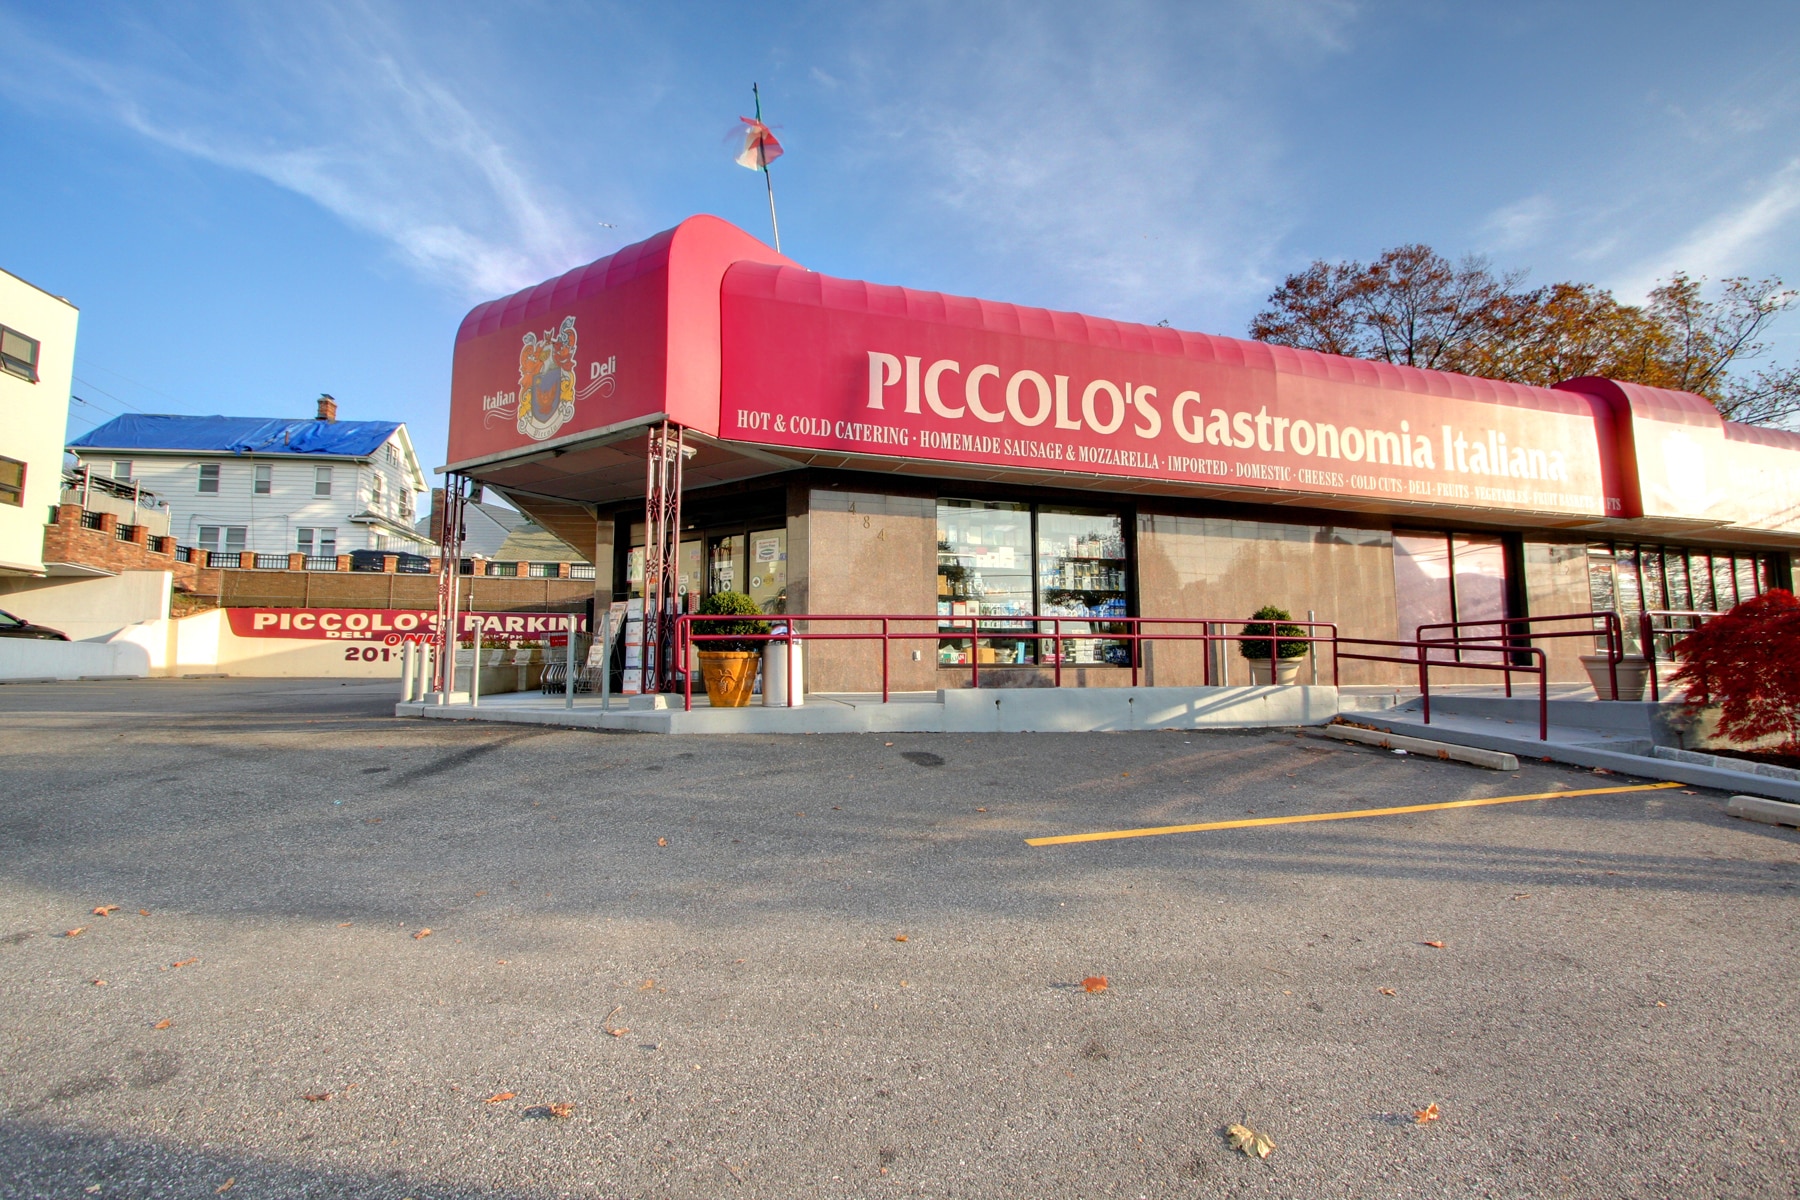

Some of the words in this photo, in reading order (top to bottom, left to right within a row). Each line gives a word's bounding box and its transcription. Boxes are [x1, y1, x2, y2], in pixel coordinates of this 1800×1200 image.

[483, 390, 515, 411] Italian
[590, 355, 616, 380] Deli
[866, 350, 1162, 439] PICCOLO'S
[1172, 390, 1436, 470] Gastronomia
[1442, 425, 1568, 482] Italiana
[737, 409, 771, 431] HOT
[774, 414, 787, 432] &
[789, 415, 831, 437] COLD
[835, 420, 909, 446] CATERING
[920, 430, 1001, 454] HOMEMADE
[1004, 438, 1063, 460] SAUSAGE
[1066, 444, 1076, 461] &
[1079, 446, 1159, 469] MOZZARELLA
[1168, 455, 1228, 476] IMPORTED
[1236, 462, 1291, 482] DOMESTIC
[1298, 468, 1344, 488] CHEESES
[1351, 474, 1377, 491] COLD
[1378, 477, 1403, 493] CUTS
[1409, 480, 1431, 495] DELI
[1437, 482, 1470, 499] FRUITS
[1475, 486, 1529, 503] VEGETABLES
[1533, 491, 1556, 506] FRUIT
[253, 613, 446, 631] PICCOLO'S
[326, 631, 373, 639] DELI
[384, 633, 460, 647] ONL
